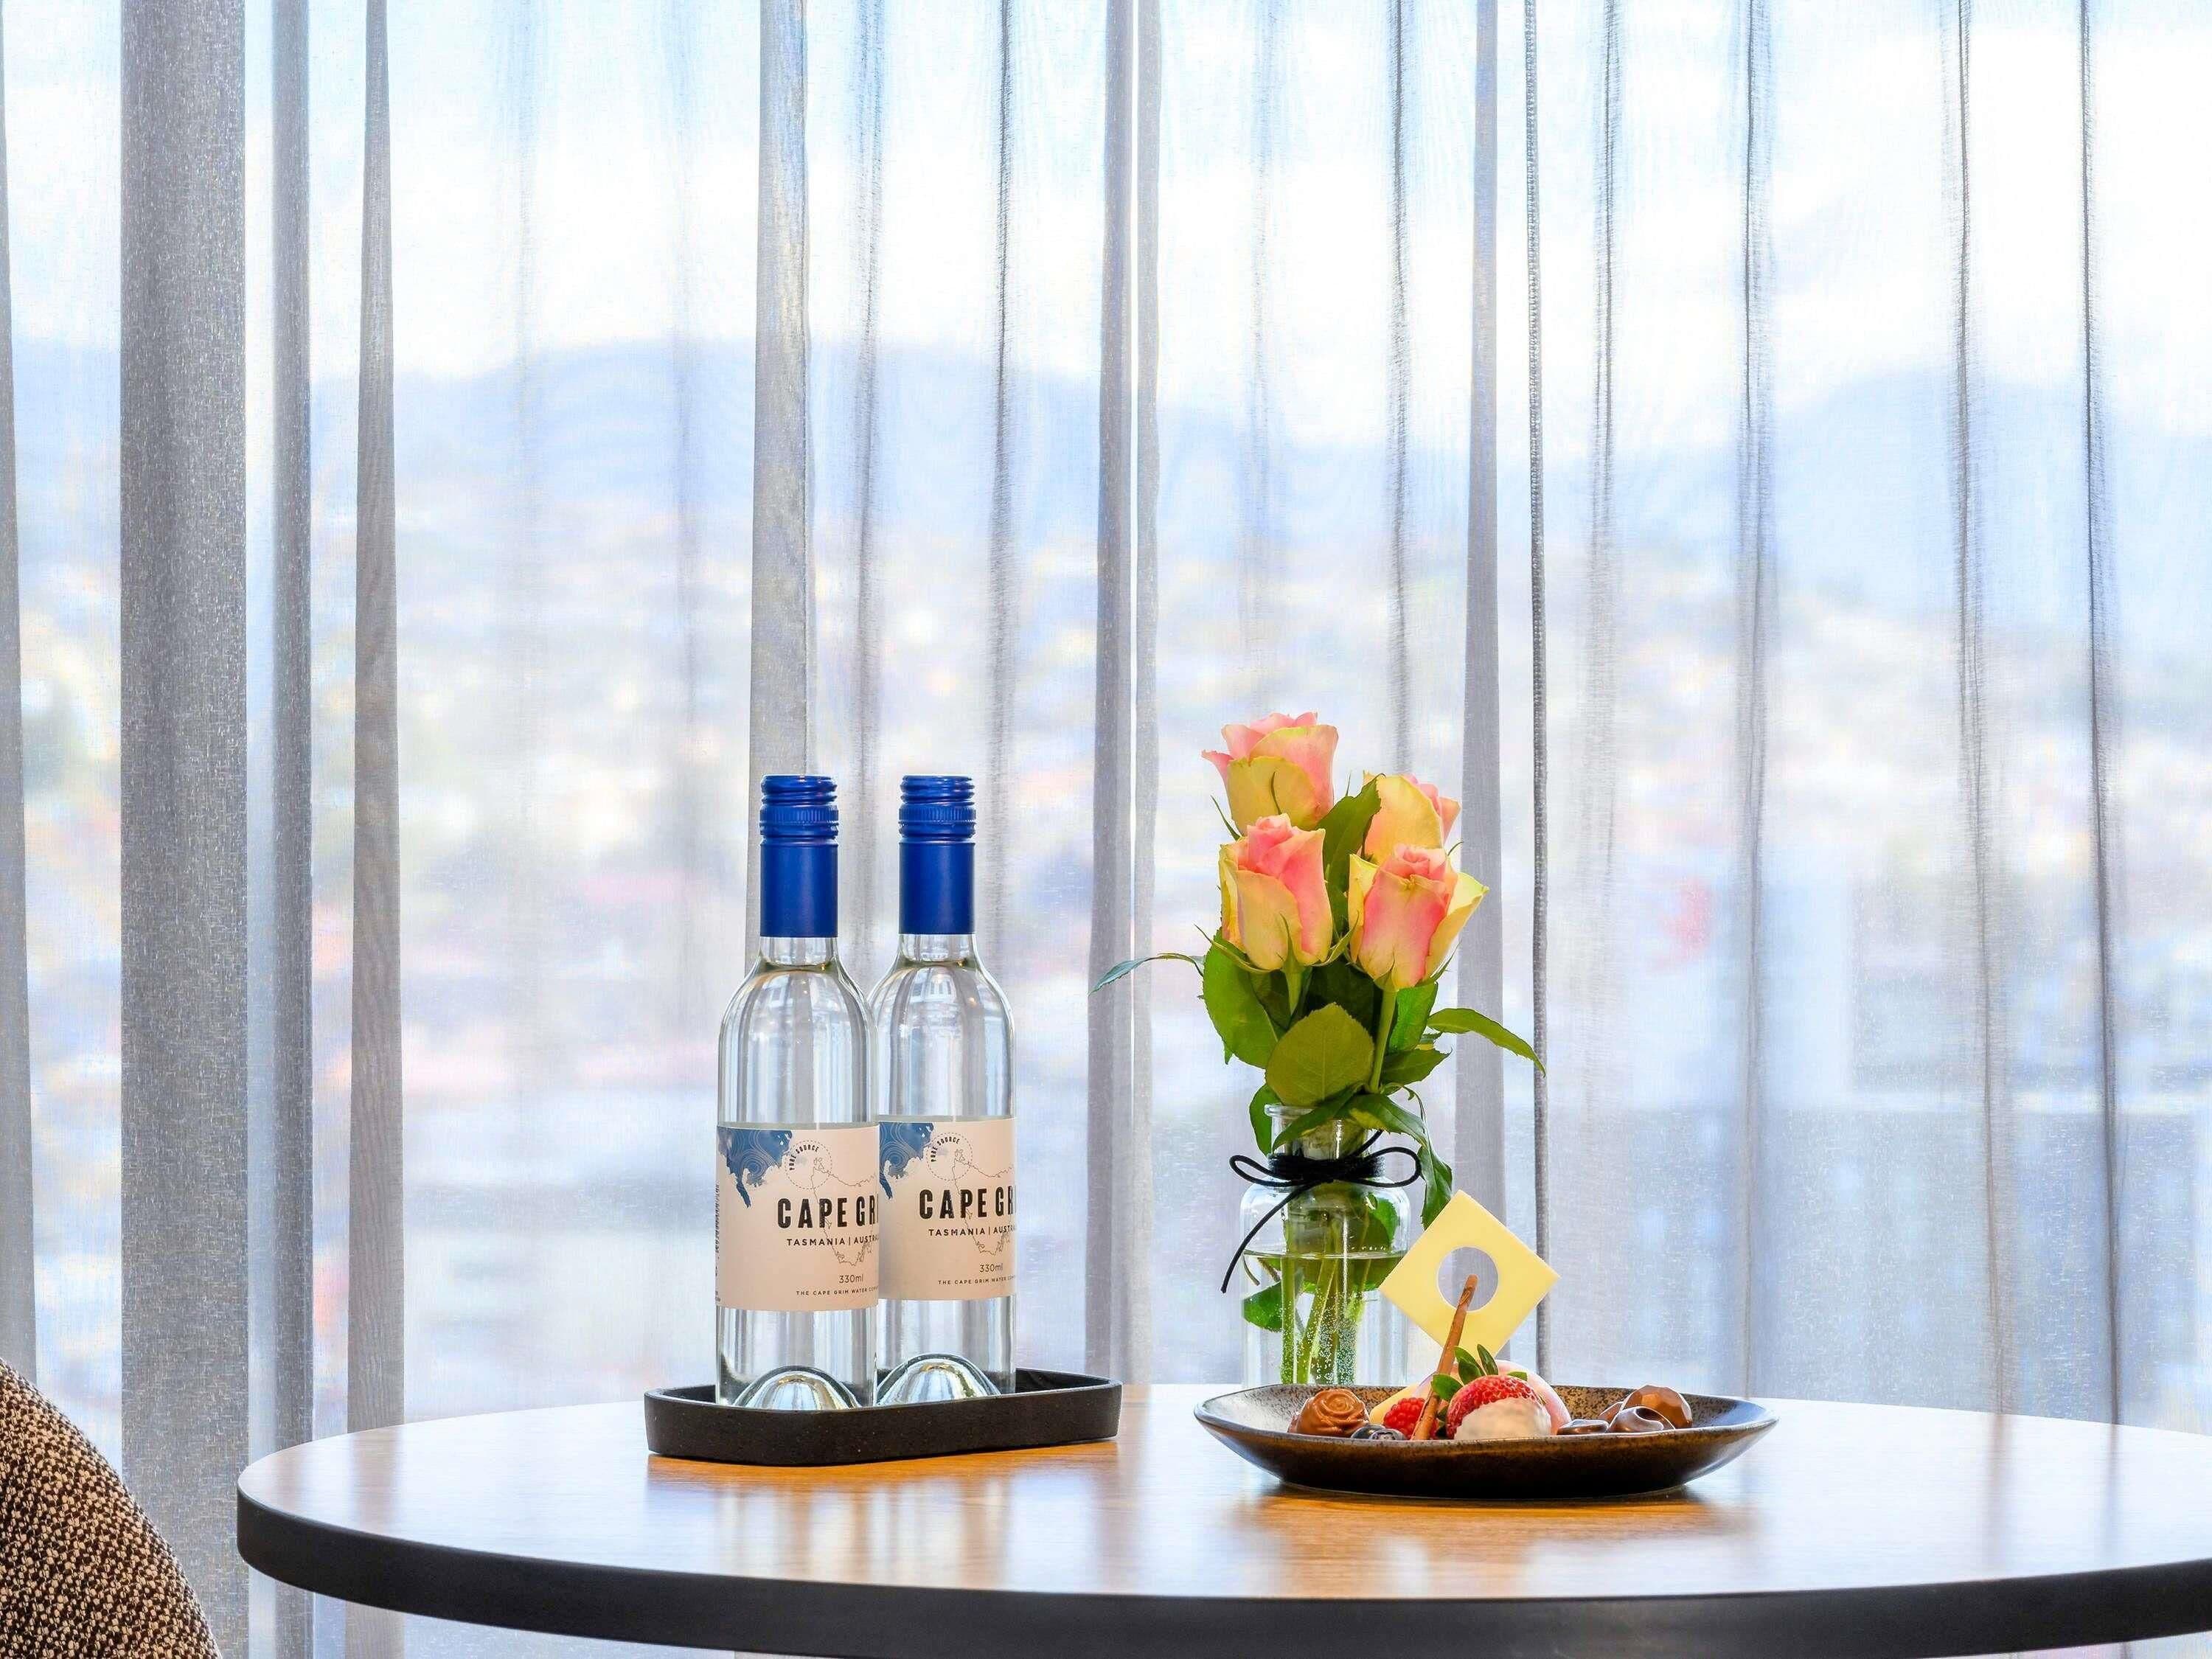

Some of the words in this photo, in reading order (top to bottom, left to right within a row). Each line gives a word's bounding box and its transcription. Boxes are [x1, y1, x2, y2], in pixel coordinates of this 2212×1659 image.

[936, 1136, 960, 1146] SOURCE
[795, 1144, 819, 1154] SOURCE
[919, 1188, 987, 1220] CAPE
[777, 1197, 848, 1229] CAPE
[928, 1228, 986, 1237] TASMANIA
[786, 1237, 846, 1246] TASMANIA
[978, 1262, 1003, 1273] 330ml
[838, 1273, 863, 1284] 330ml
